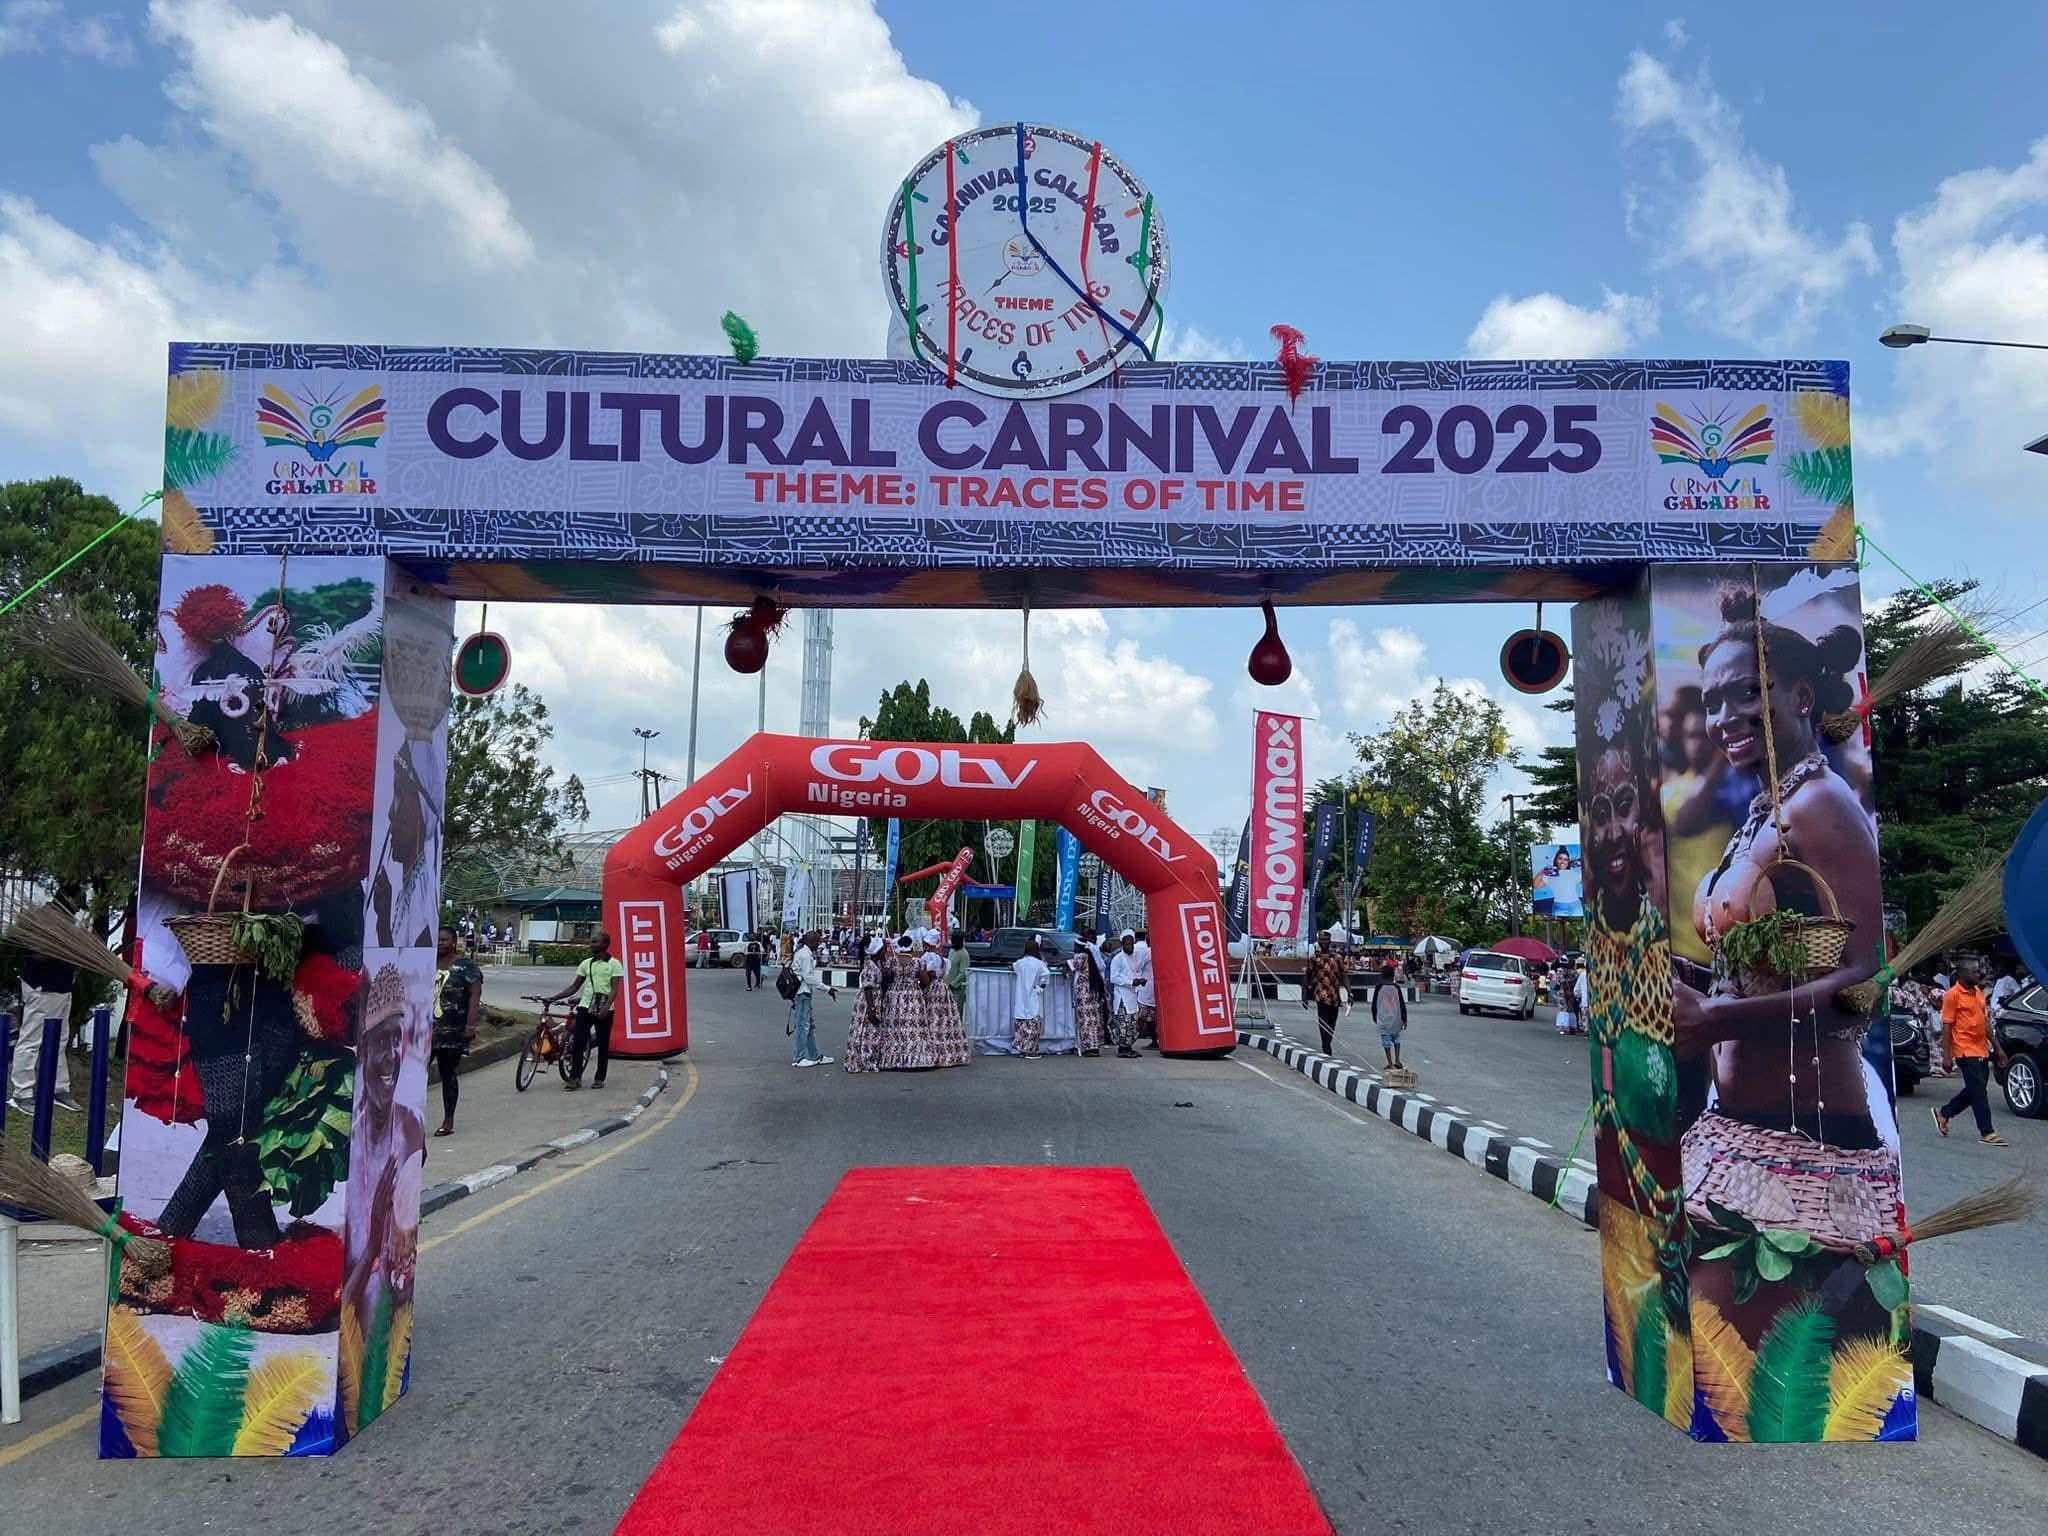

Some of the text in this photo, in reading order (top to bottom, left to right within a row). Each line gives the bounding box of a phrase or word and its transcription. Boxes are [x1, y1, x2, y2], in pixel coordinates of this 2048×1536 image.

[993, 194, 1057, 213] 2025
[994, 296, 1054, 311] THEME
[1026, 320, 1055, 346] OF
[1017, 361, 1028, 375] 6
[427, 388, 1602, 475] CULTURAL CARNIVAL 2025
[273, 460, 369, 479] CARNIVAL
[1670, 477, 1762, 496] CARNIVAL
[744, 472, 1305, 512] THEME: TRACES OF TIME
[807, 782, 907, 808] Nigeria
[1077, 802, 1121, 839] Nigeria
[1256, 717, 1298, 938] showmax
[665, 833, 715, 871] Nigeria
[1233, 874, 1249, 919] FirstBank
[632, 915, 660, 1025] LOVE IT
[1193, 915, 1226, 1021] LOVE IT
